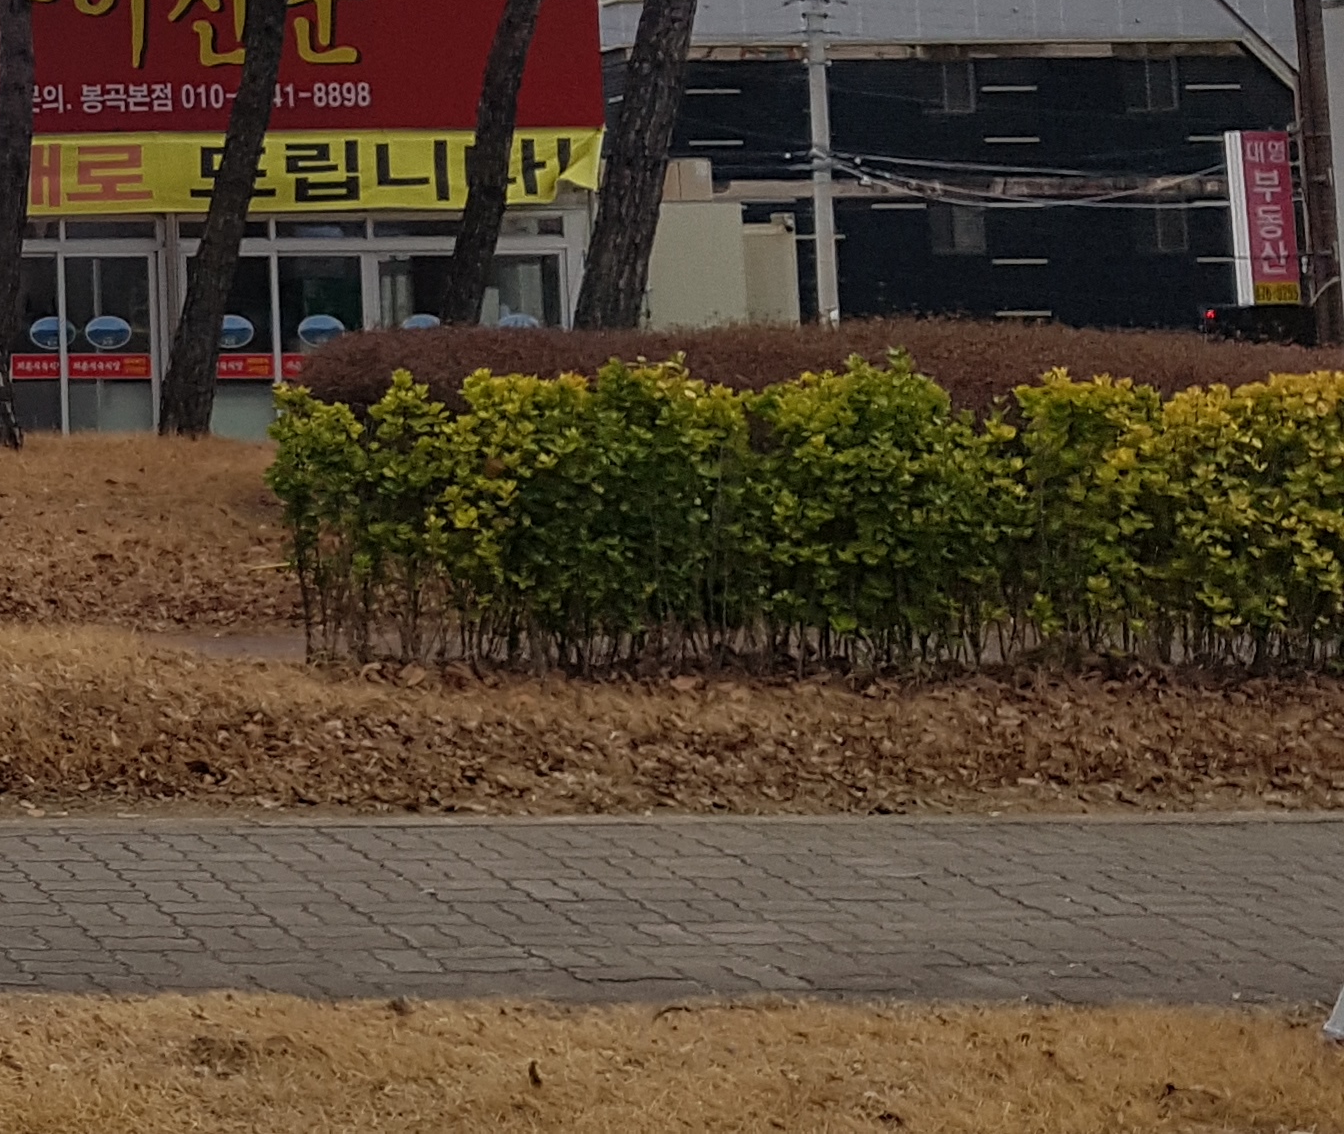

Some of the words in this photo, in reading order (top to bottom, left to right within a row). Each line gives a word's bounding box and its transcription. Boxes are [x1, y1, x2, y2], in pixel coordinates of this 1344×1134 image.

[80, 82, 173, 114] 봉곡본점
[181, 81, 371, 109] 010-41-8898
[1245, 139, 1287, 164] 대영
[1253, 169, 1289, 275] 부동산
